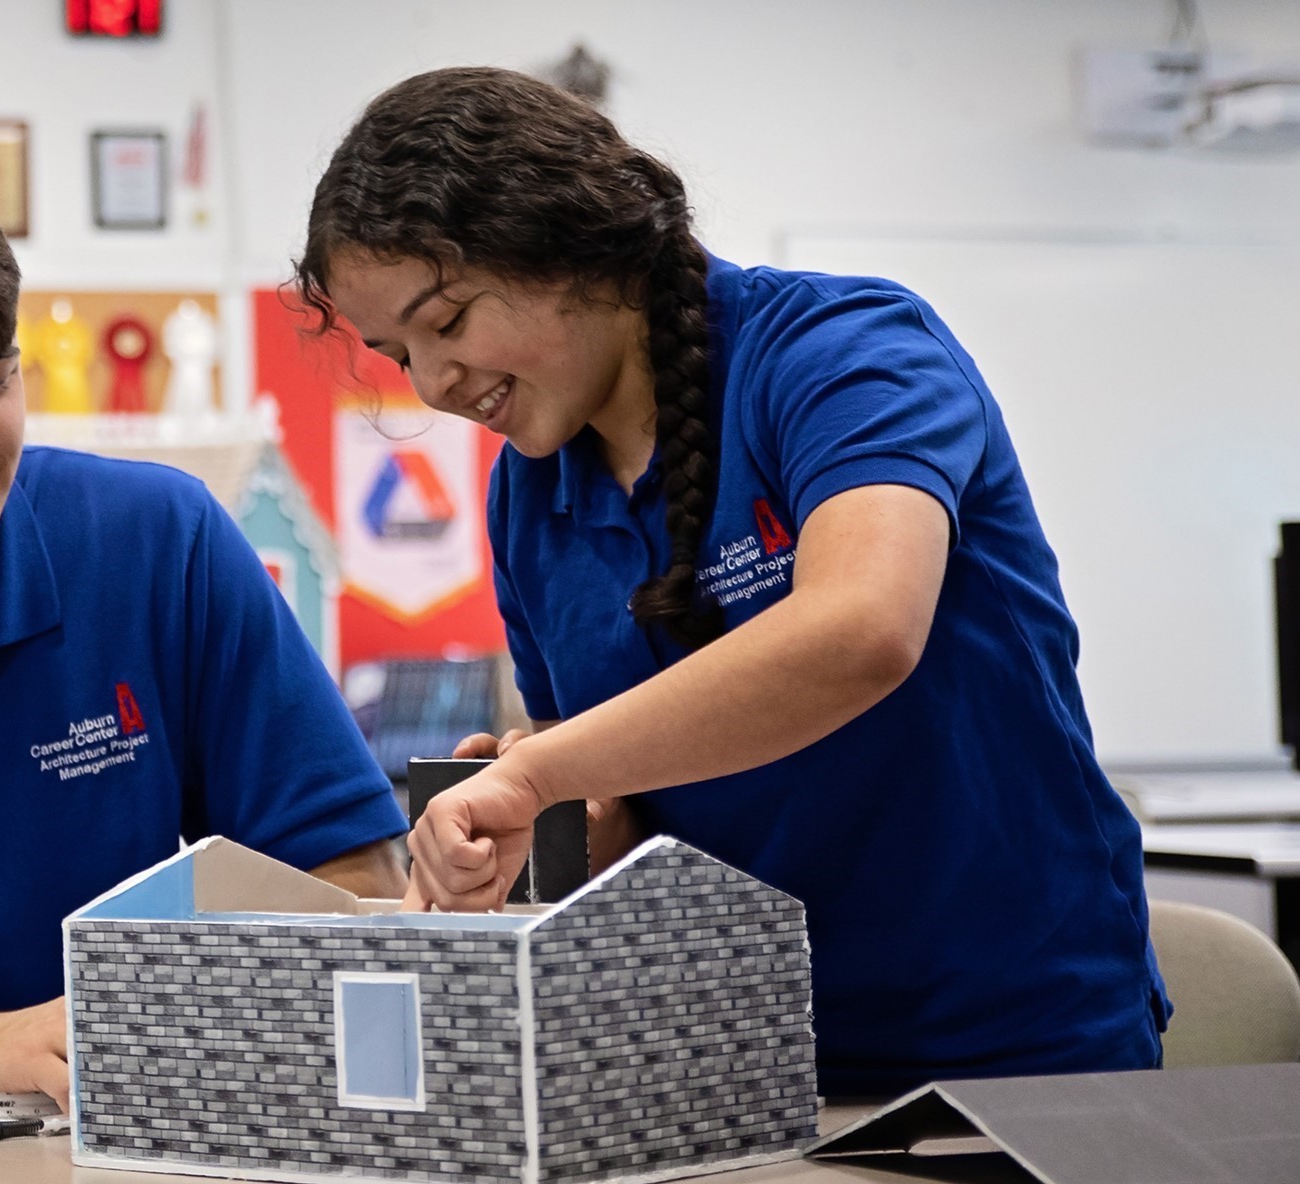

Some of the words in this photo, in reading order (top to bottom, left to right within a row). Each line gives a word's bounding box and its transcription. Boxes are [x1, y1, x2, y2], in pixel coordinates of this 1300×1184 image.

[720, 535, 757, 560] Auburn
[726, 548, 761, 570] Center
[68, 714, 115, 736] Auburn
[30, 738, 74, 758] Career
[74, 726, 118, 747] Center
[40, 746, 107, 771] Architecture
[110, 733, 149, 752] Project
[58, 751, 136, 781] Management
